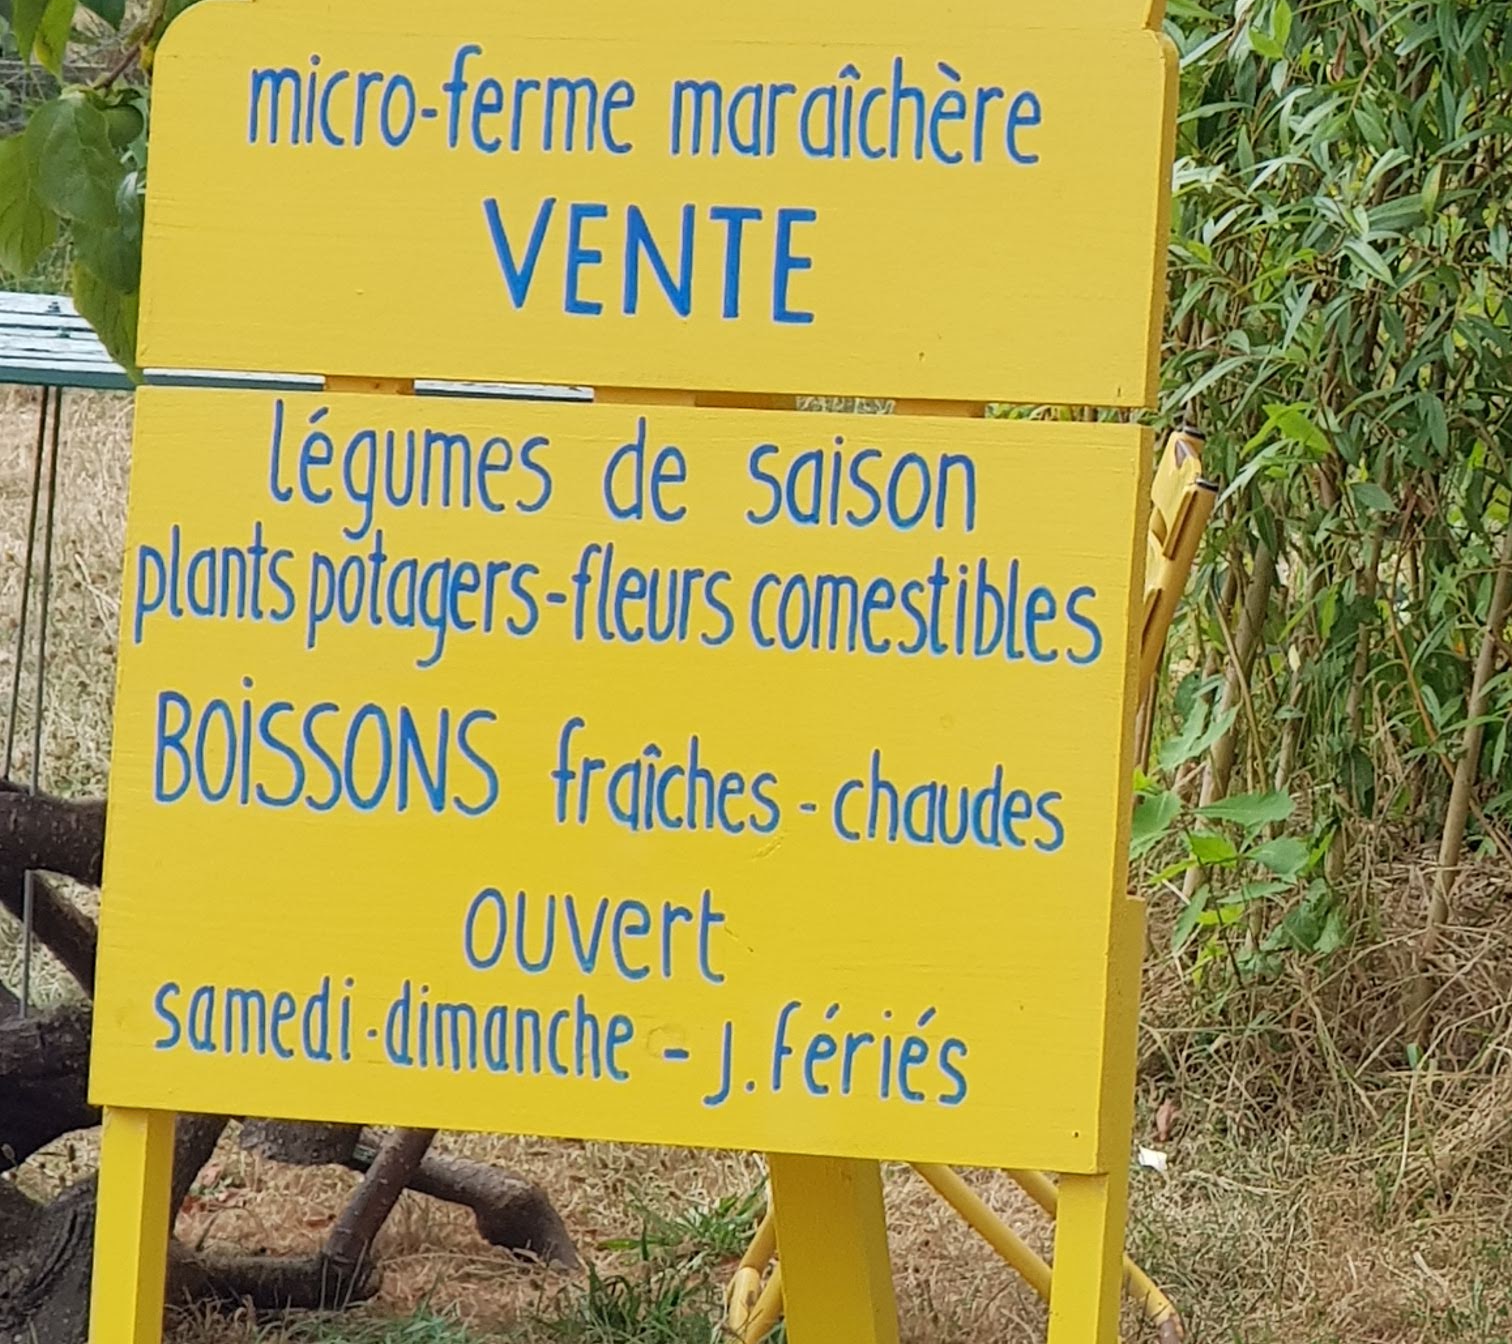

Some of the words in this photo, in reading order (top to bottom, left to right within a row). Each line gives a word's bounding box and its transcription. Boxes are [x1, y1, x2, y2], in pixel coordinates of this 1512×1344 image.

[247, 44, 635, 156] micro-ferme
[669, 57, 1041, 166] maraîchère
[482, 197, 817, 326] VENTE
[269, 400, 552, 543] légumes
[602, 419, 687, 524] de
[746, 437, 976, 533] saison
[133, 523, 296, 645] plants
[749, 558, 1102, 667] comestibles
[552, 718, 780, 835] fraîches
[800, 804, 815, 813] -
[833, 752, 1064, 853] chaudes
[463, 889, 724, 984] ouvert
